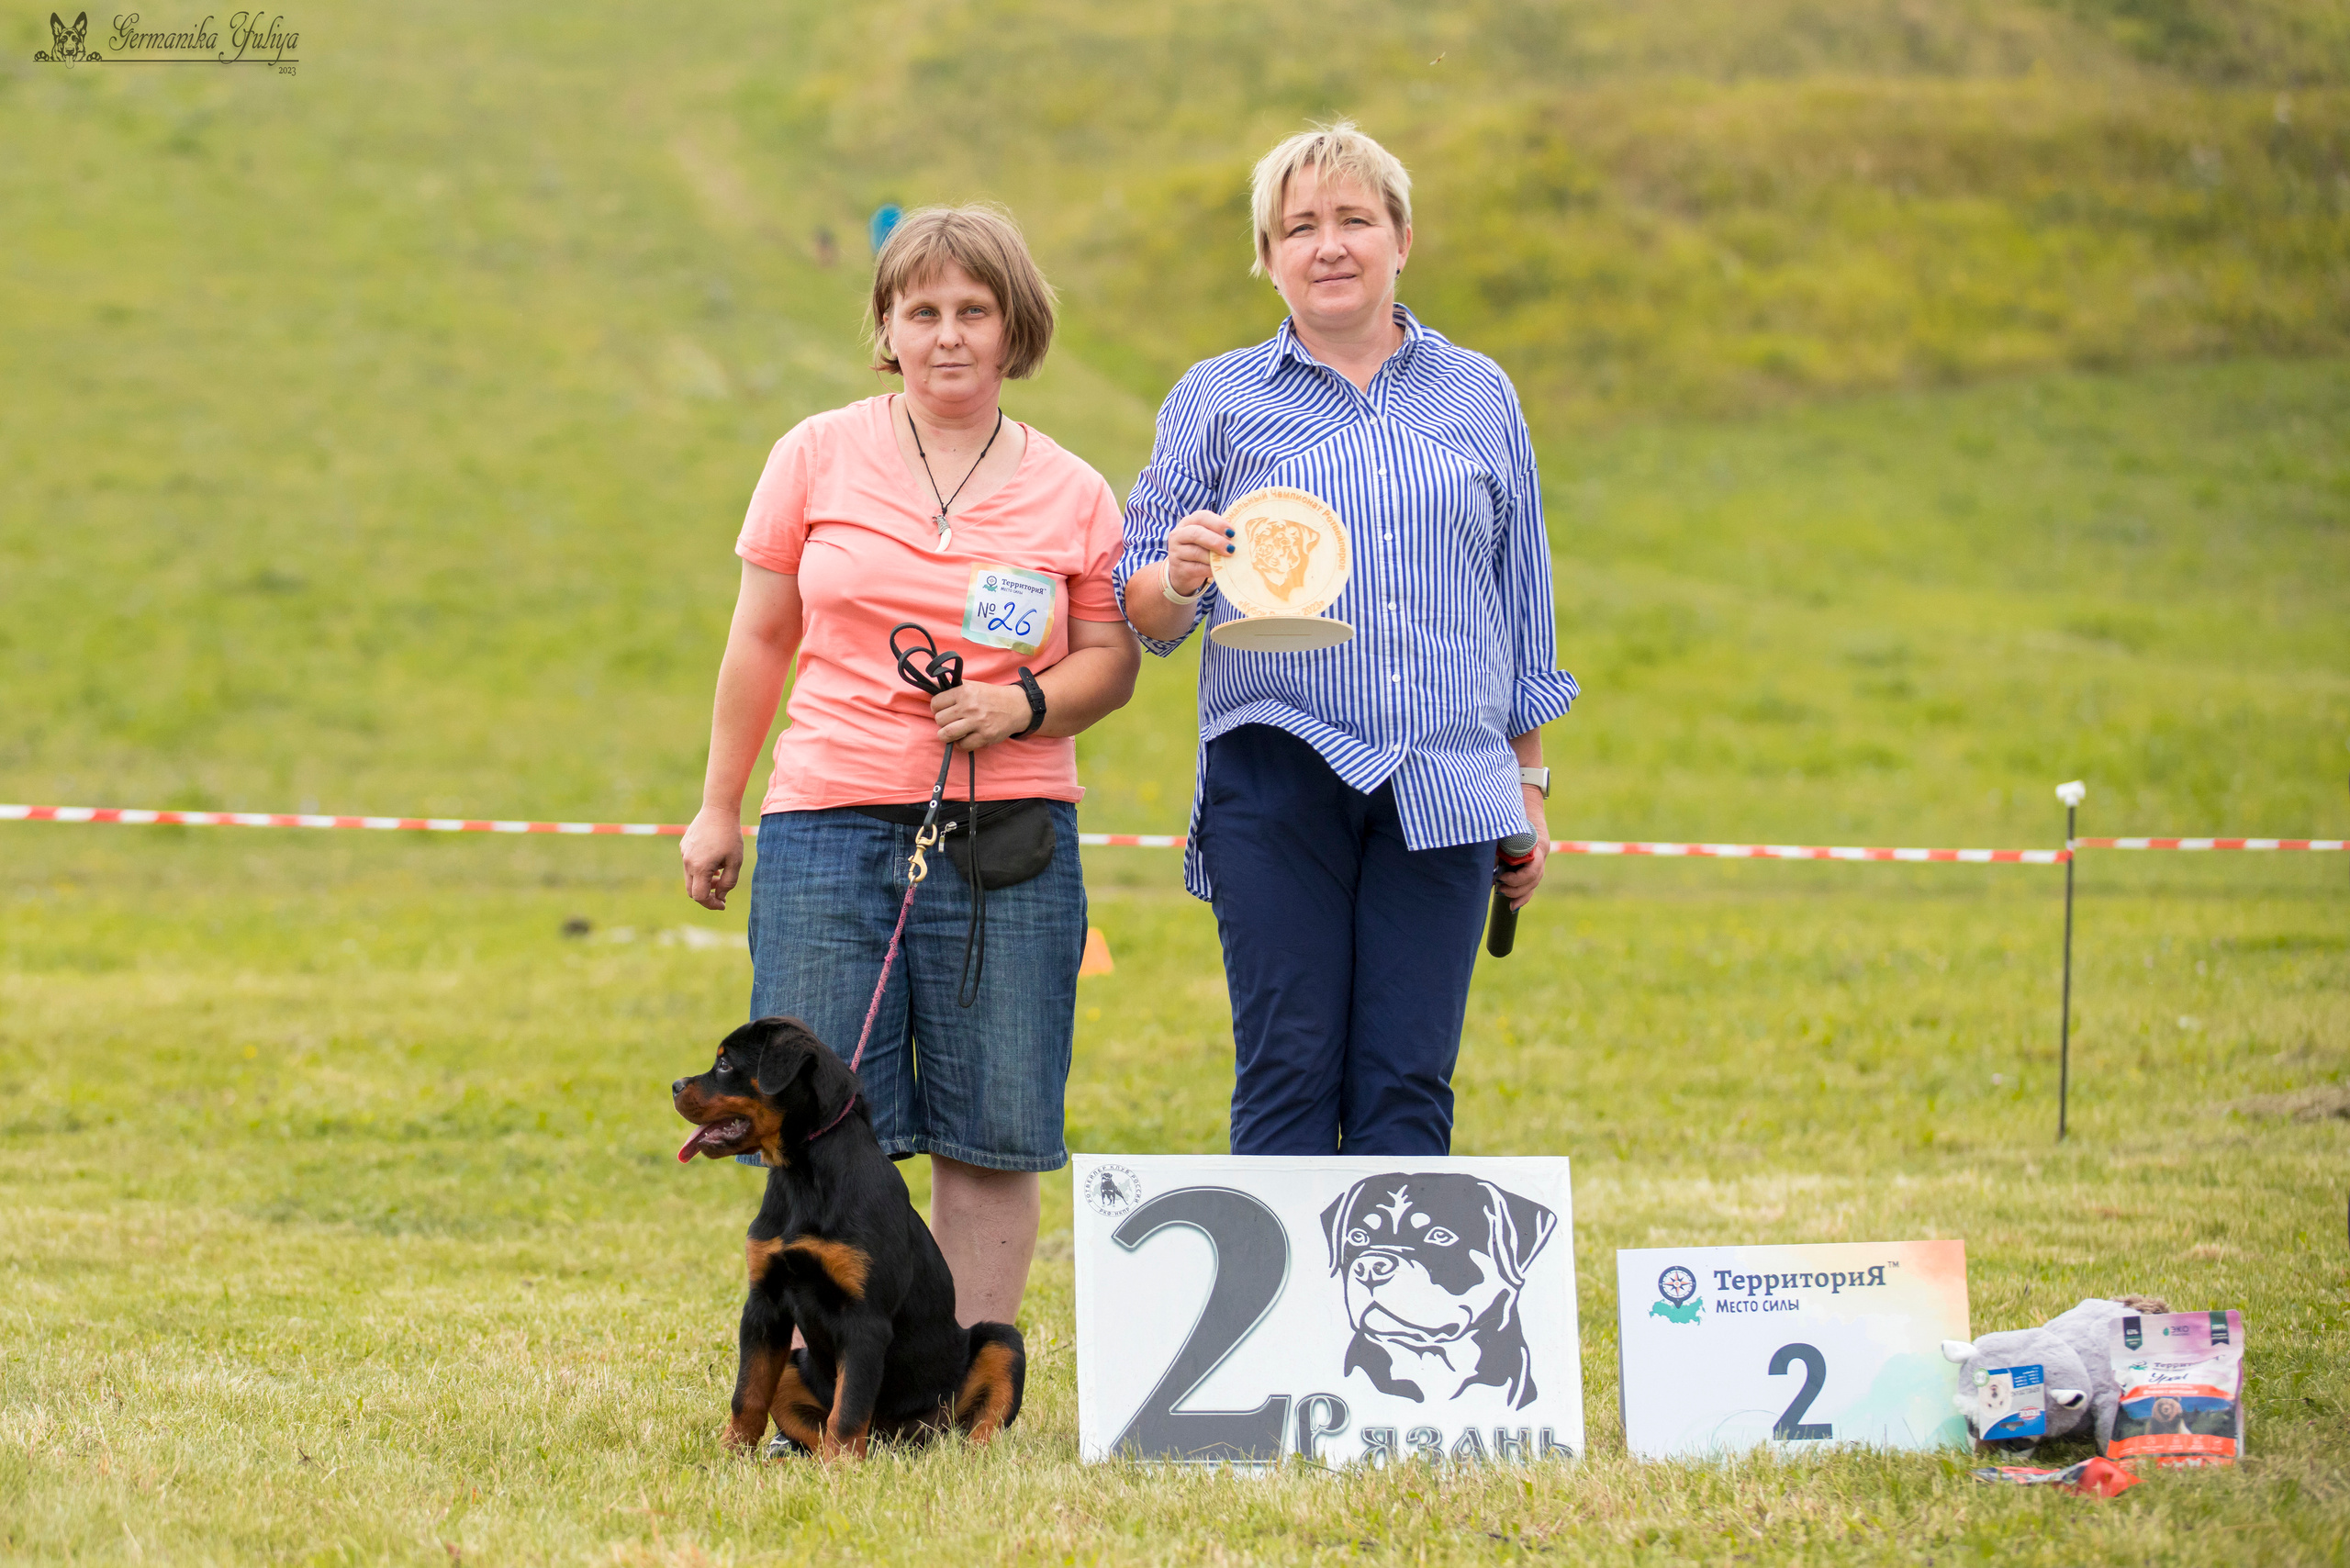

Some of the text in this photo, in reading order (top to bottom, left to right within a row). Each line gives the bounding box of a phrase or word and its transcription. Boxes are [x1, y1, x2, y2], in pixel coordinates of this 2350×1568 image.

[1270, 488, 1323, 511] Чемпионат
[1322, 509, 1348, 571] Ротвейлеров
[987, 601, 1037, 636] 26
[1110, 1165, 1131, 1174] КЛУБ
[1131, 1174, 1142, 1204] РОССИИ
[1110, 1185, 1292, 1464] 2
[2171, 1325, 2190, 1334] ЭКО
[1767, 1342, 1834, 1441] 2
